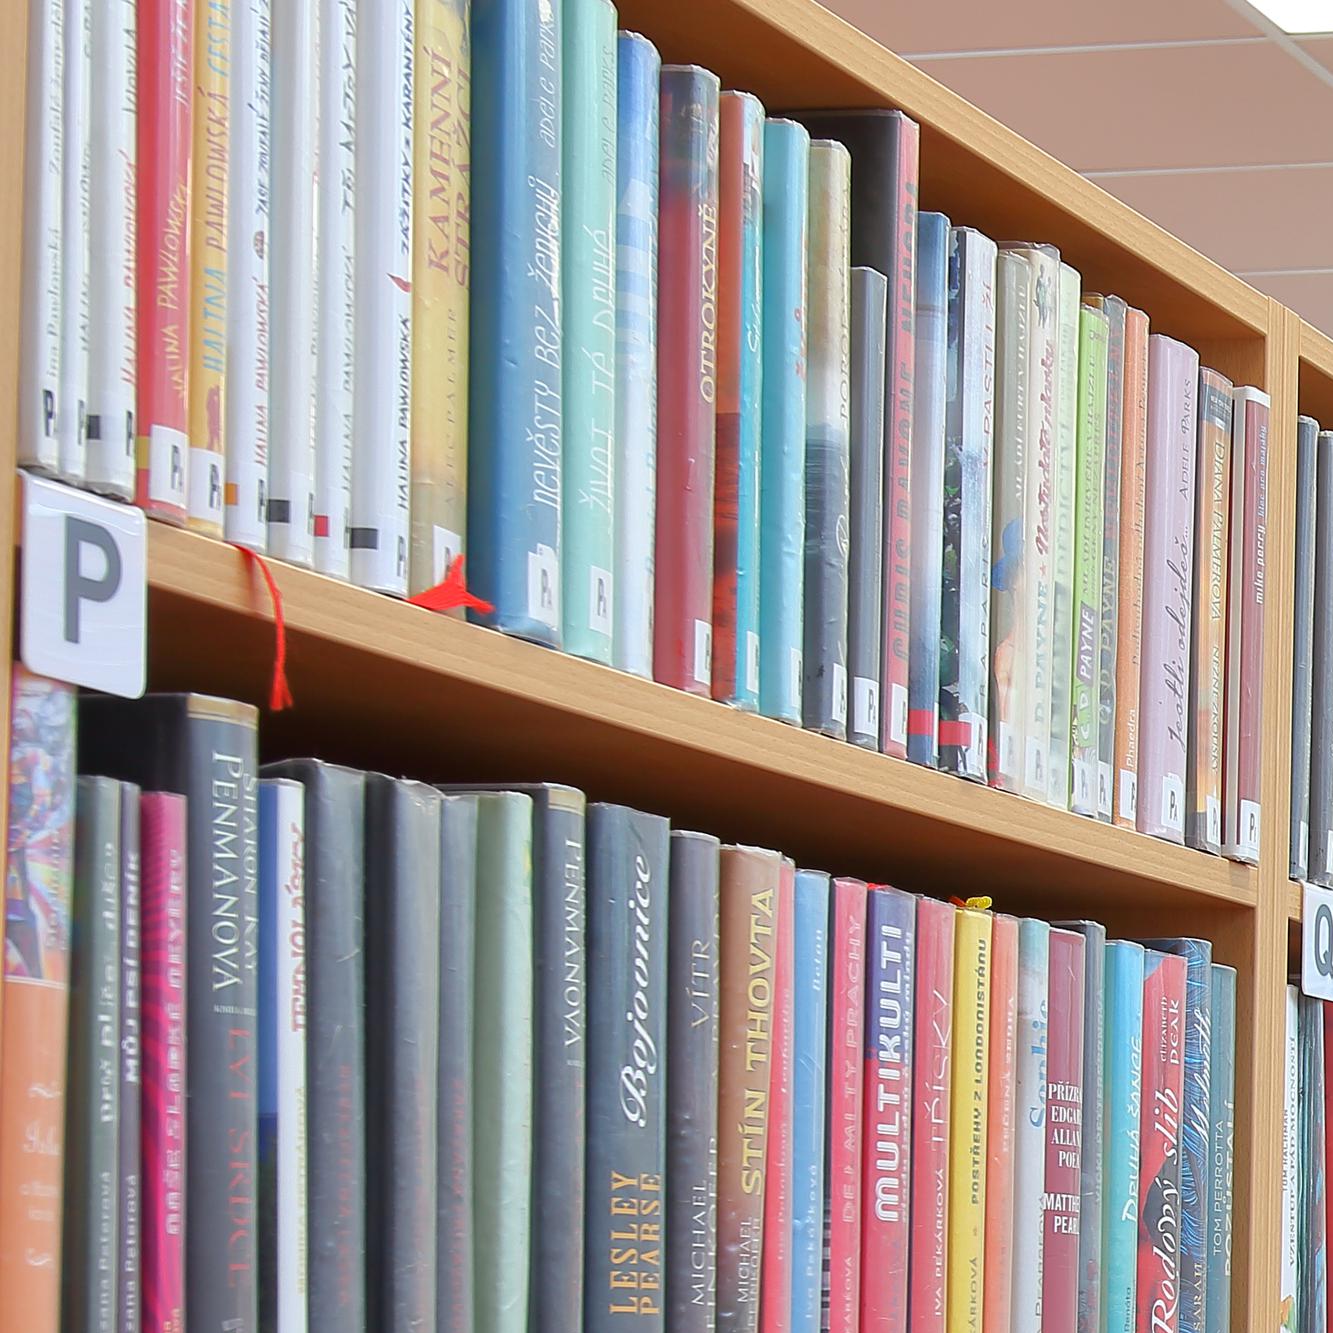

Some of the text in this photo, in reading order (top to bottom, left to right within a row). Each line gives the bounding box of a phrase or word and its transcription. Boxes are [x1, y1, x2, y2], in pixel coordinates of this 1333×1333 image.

[65, 516, 121, 644] P
[1079, 606, 1096, 680] PAYNE
[619, 851, 657, 1128] Bojovnice
[874, 923, 902, 1224] MULTIKULTI
[1148, 1087, 1178, 1167] slib
[738, 1089, 768, 1197] STÍN
[608, 1170, 640, 1316] LESLEY
[1213, 1220, 1223, 1256] TOM
